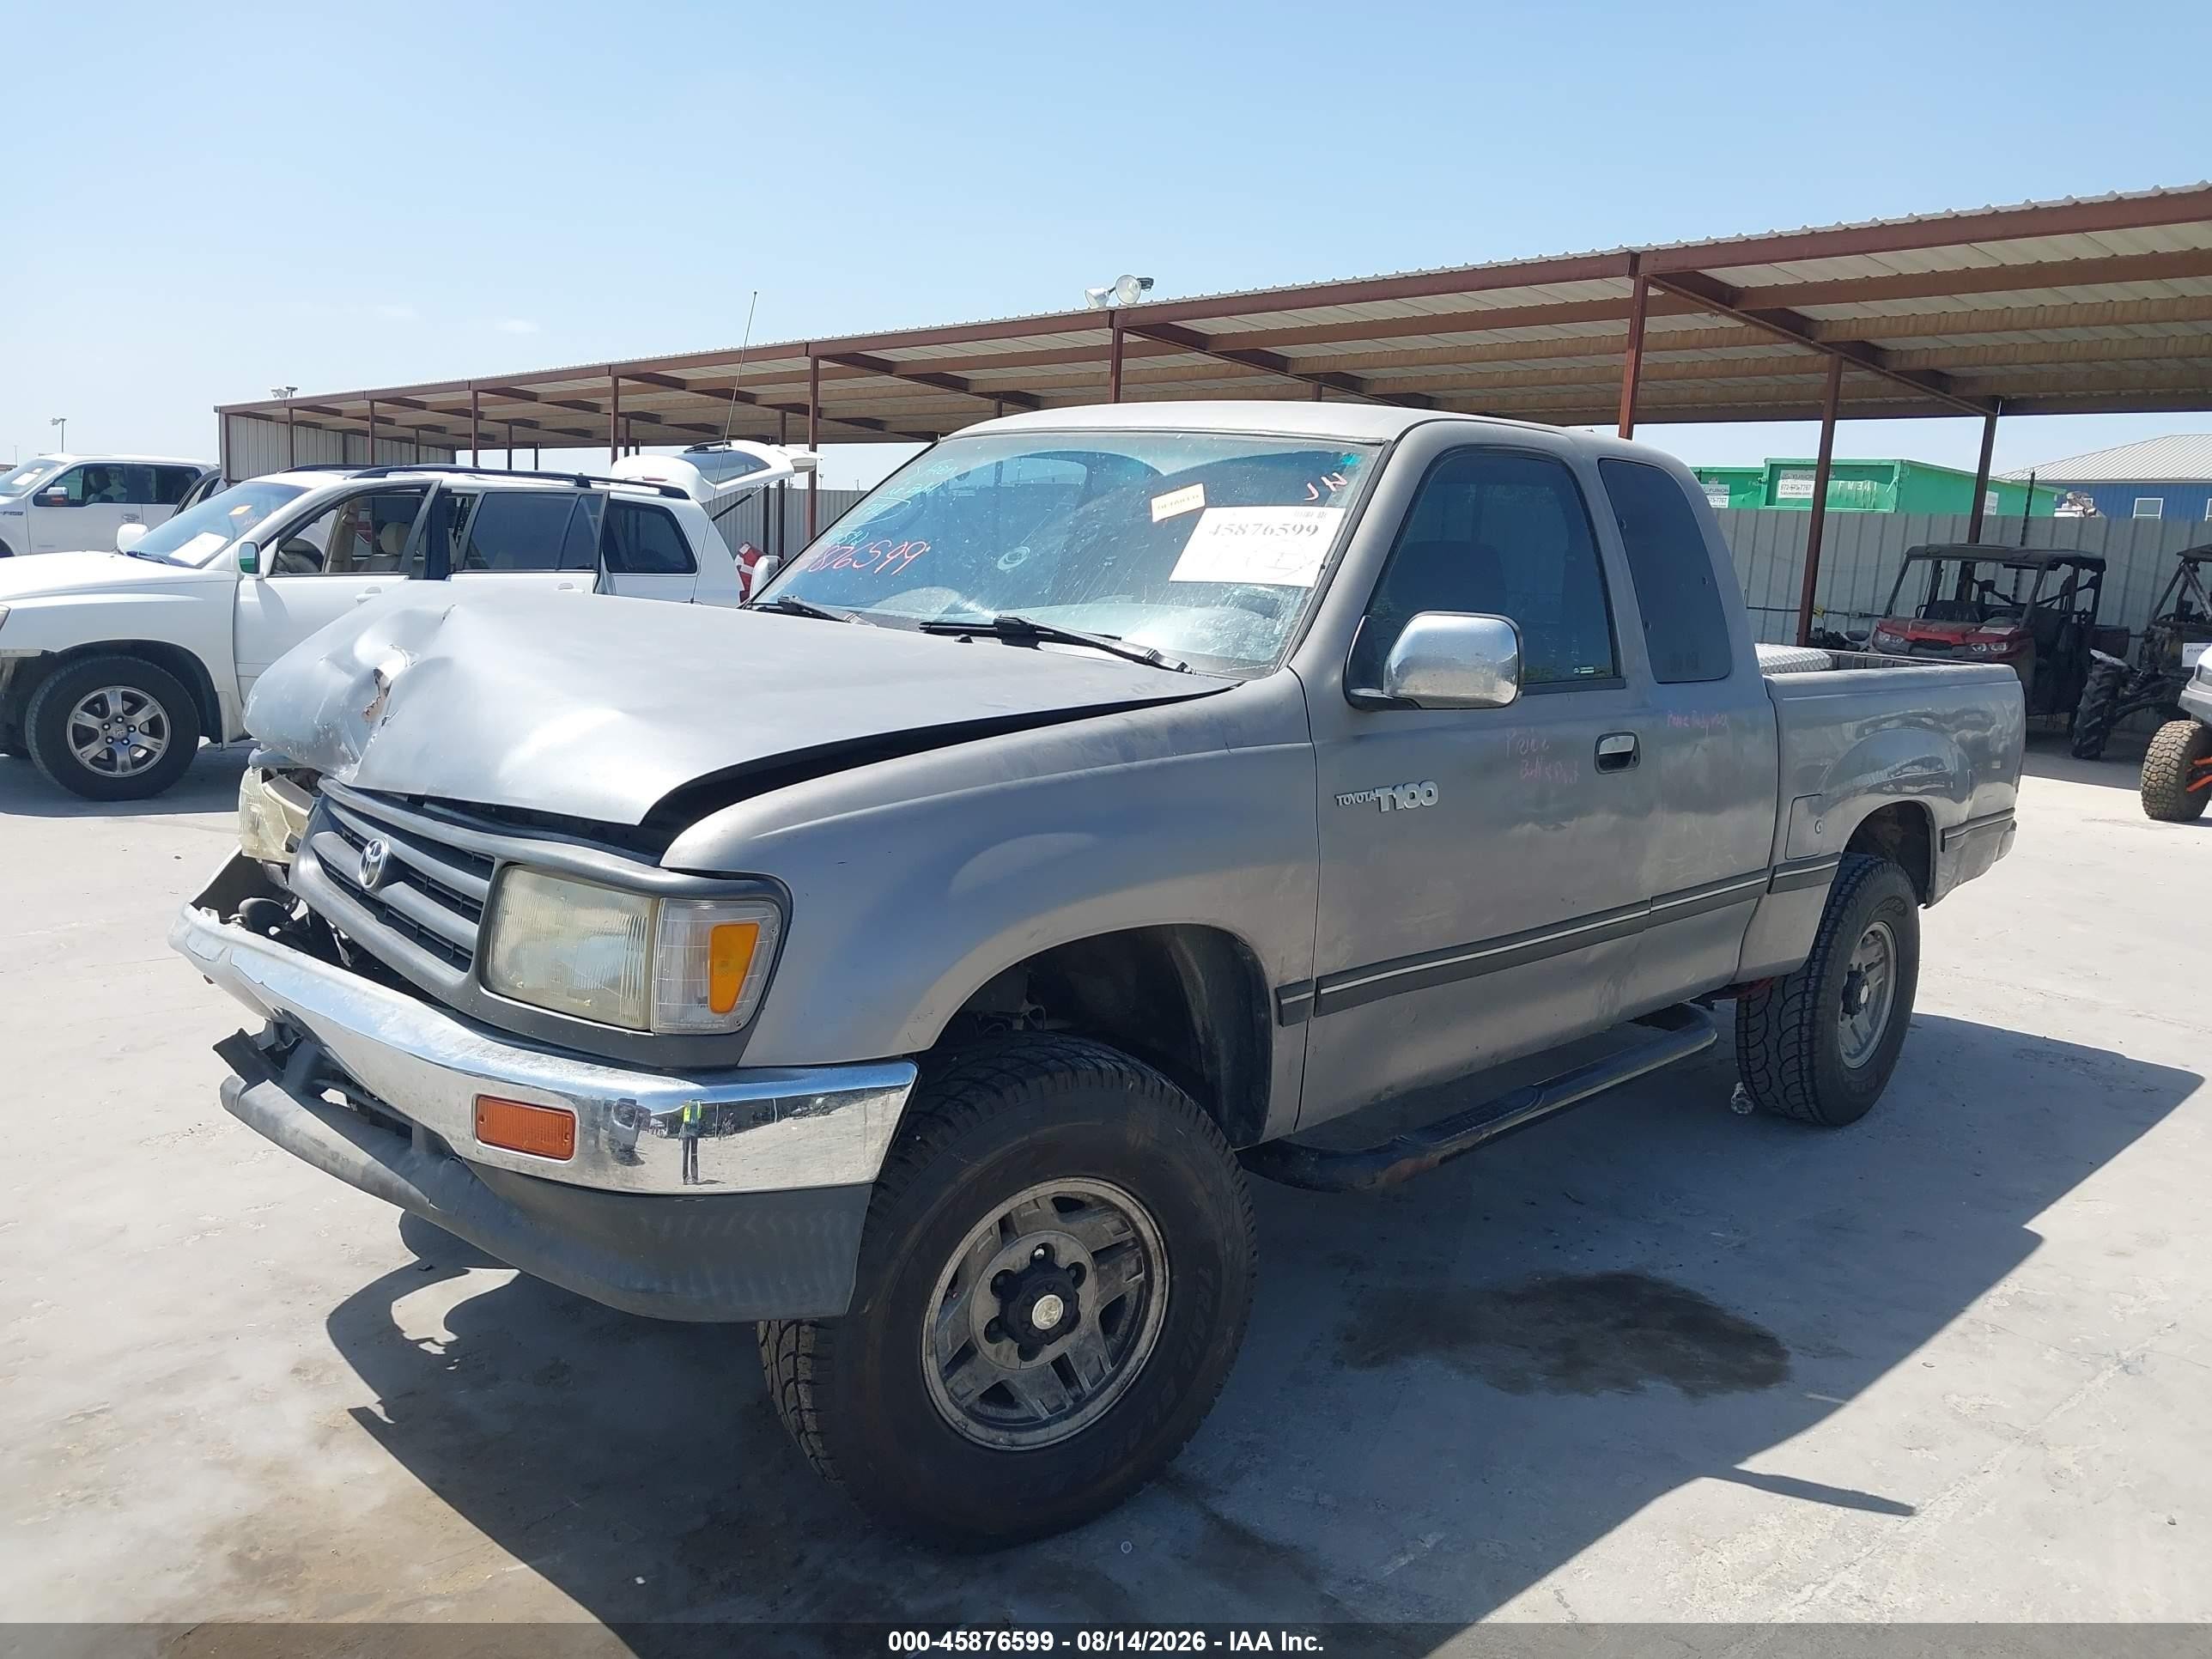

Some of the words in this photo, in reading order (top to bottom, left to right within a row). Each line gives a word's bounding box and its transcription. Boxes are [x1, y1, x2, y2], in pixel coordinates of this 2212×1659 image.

[1208, 522, 1320, 538] 45876599
[1335, 790, 1376, 806] TOYOTA
[1374, 779, 1439, 812] T100
